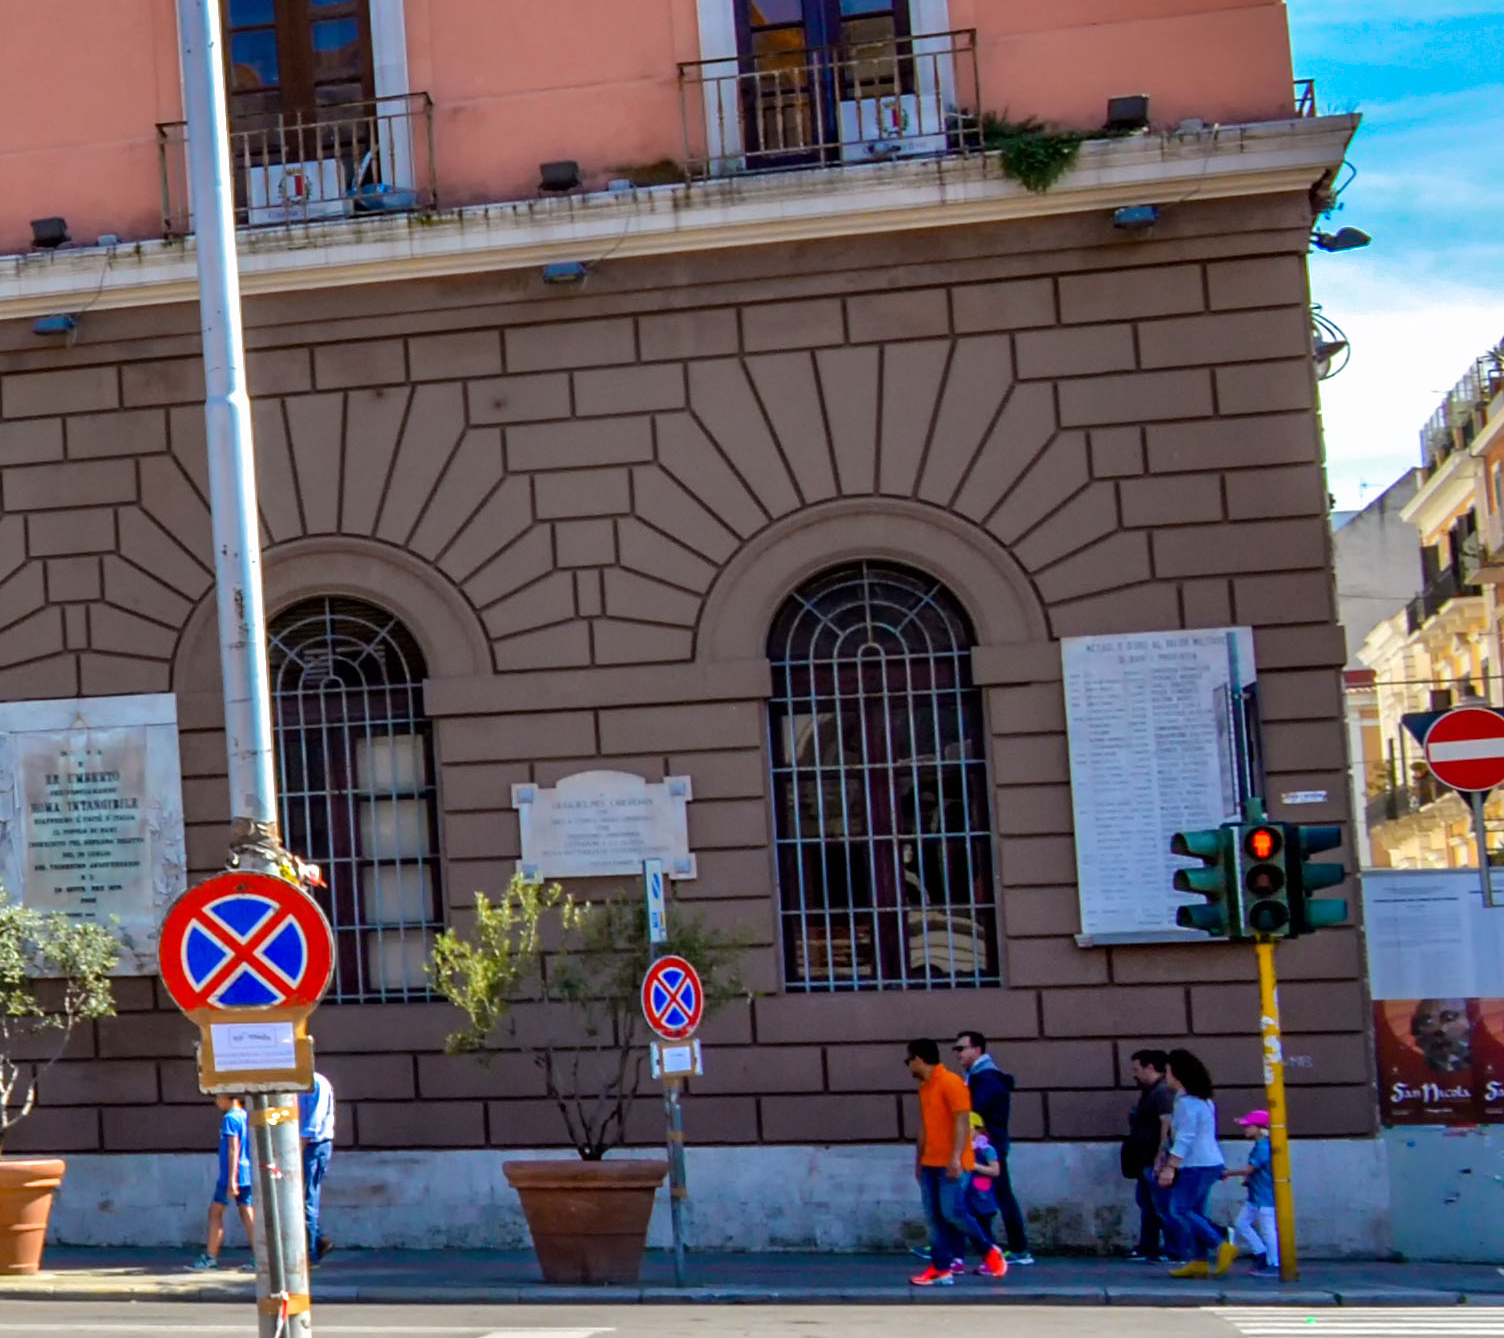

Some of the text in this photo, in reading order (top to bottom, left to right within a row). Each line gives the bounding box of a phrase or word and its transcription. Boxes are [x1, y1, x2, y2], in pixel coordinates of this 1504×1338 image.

[1390, 1082, 1471, 1103] San Nicola
[1484, 1080, 1504, 1101] Sa
